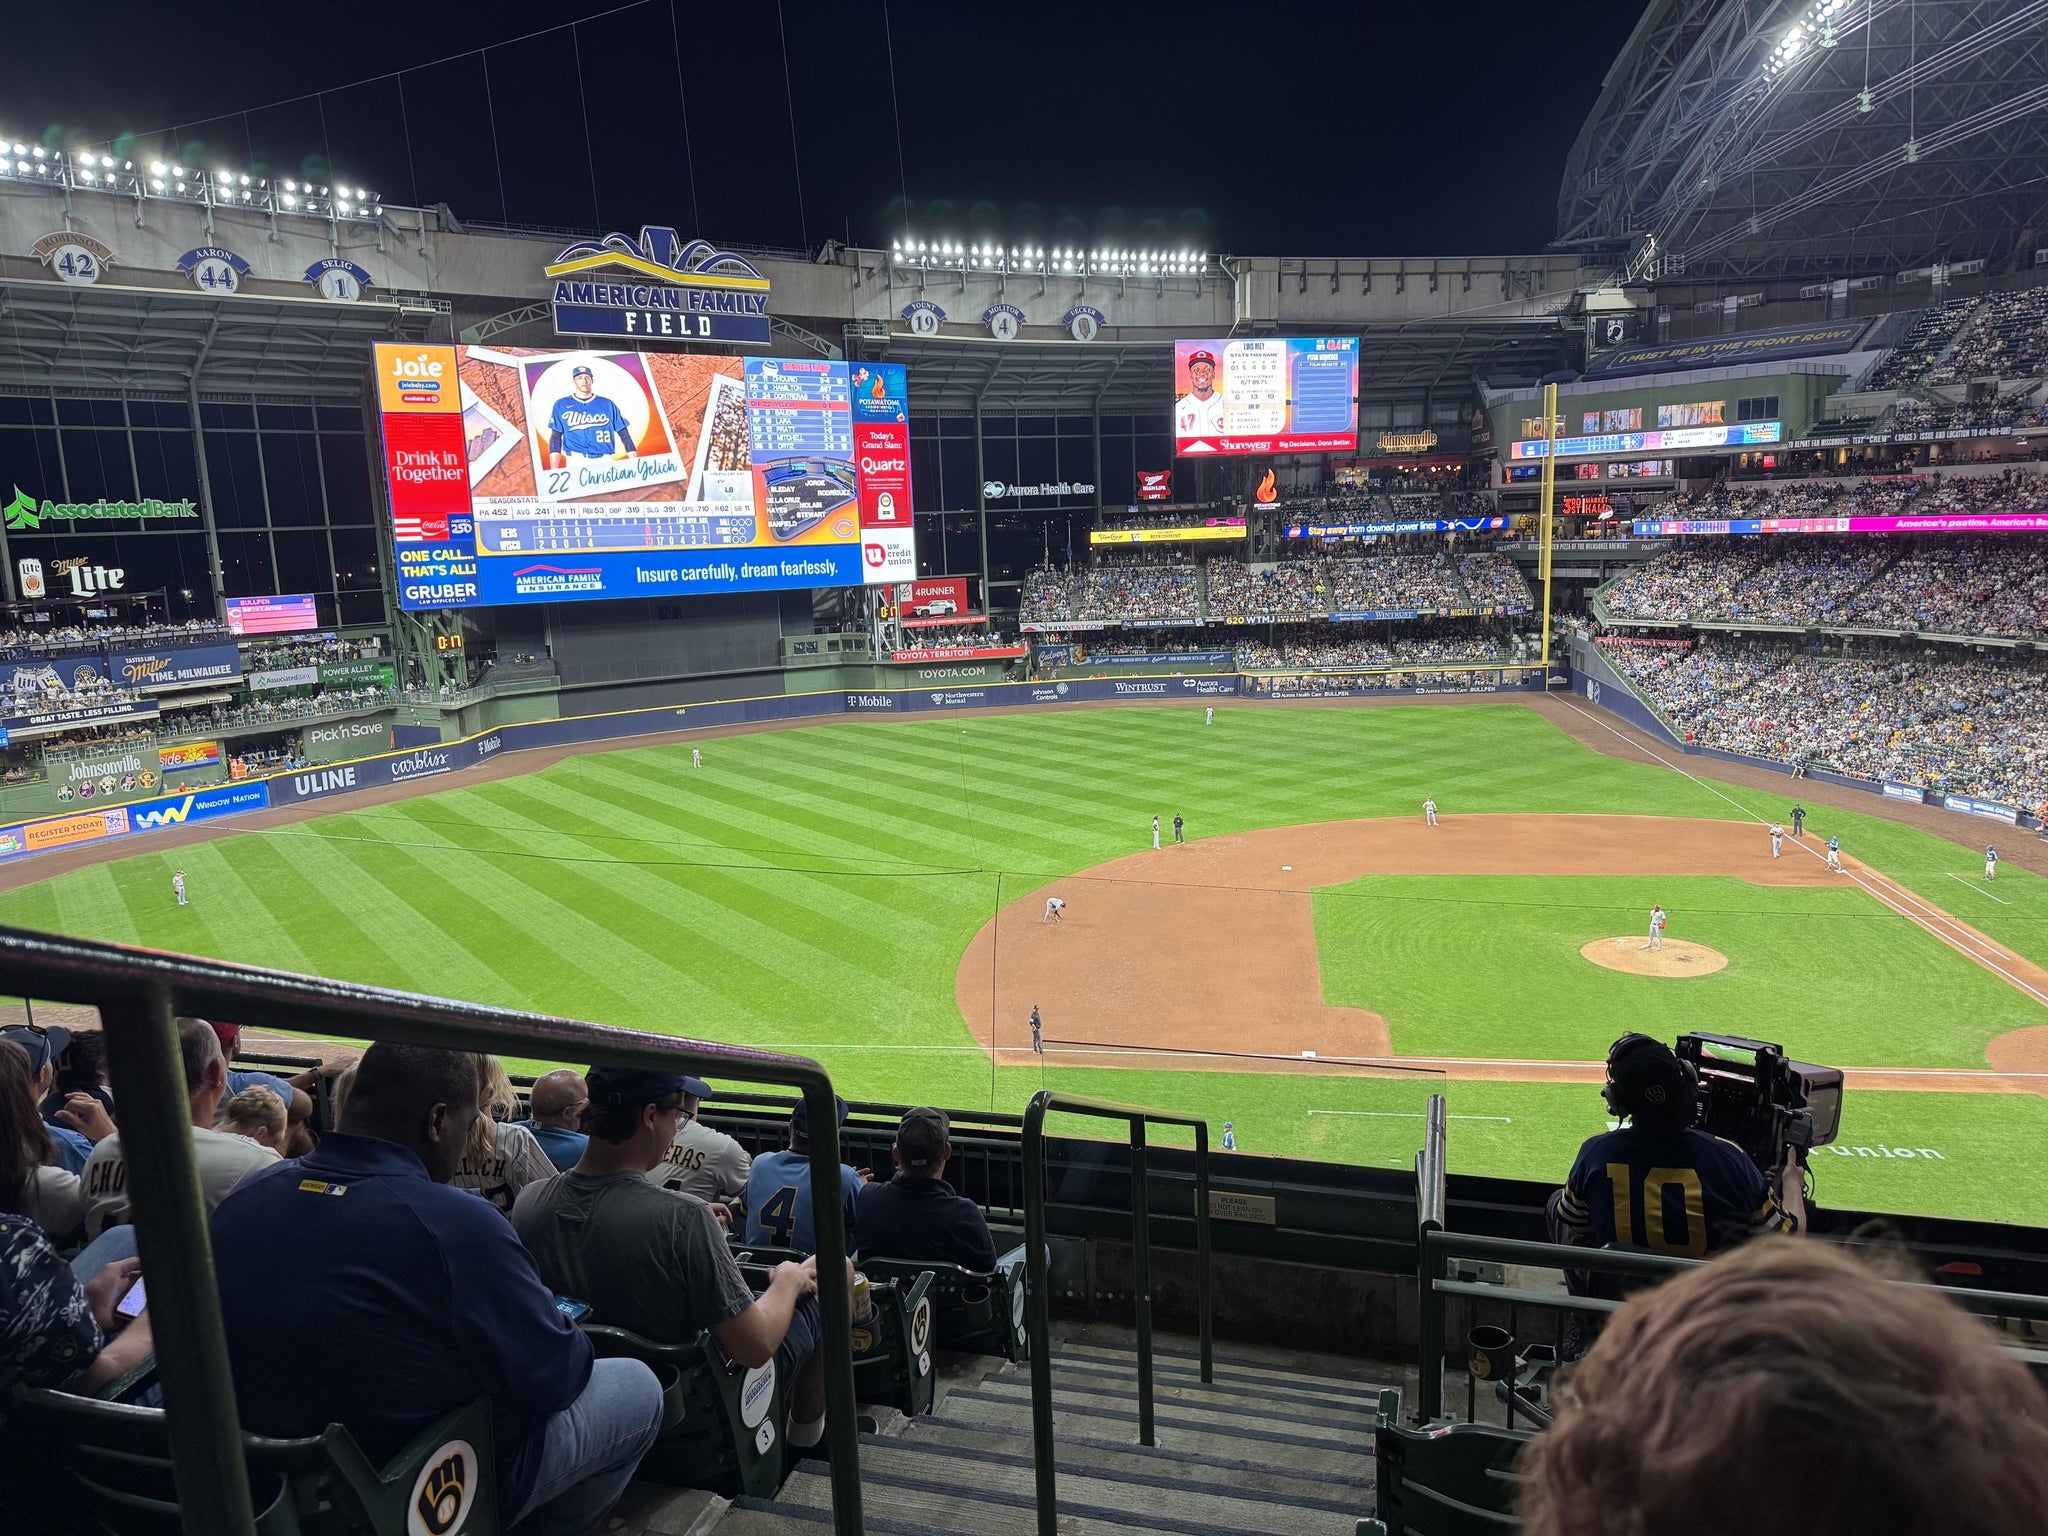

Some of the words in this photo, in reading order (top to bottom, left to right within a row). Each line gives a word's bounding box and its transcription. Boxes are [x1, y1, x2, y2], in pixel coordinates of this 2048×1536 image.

[42, 231, 103, 256] ROBINSON
[195, 247, 233, 263] AARON
[58, 253, 96, 278] 42
[321, 258, 353, 272] SELIG
[200, 265, 234, 289] 44
[335, 278, 348, 299] 1
[552, 281, 682, 311] AMERICAN
[686, 290, 769, 315] FAMILY
[911, 301, 936, 312] YOUNT
[988, 304, 1020, 317] MOLITOR
[1069, 306, 1097, 317] UECKER
[625, 311, 711, 337] FIELD
[913, 315, 935, 333] 19
[998, 319, 1008, 334] 4
[1628, 351, 1669, 362] MUST
[1670, 348, 1690, 356] BE
[1692, 345, 1710, 354] IN
[1712, 342, 1742, 351] THE
[1744, 335, 1797, 348] FRONT
[1801, 329, 1853, 342] ROW!
[392, 353, 442, 378] Joie
[561, 410, 610, 431] Wisco
[1180, 413, 1196, 432] 47
[595, 430, 611, 443] 22
[869, 431, 894, 442] Today's
[1278, 441, 1288, 449] Big
[1289, 440, 1316, 448] Decisions,
[1318, 439, 1332, 447] Done
[1332, 438, 1352, 446] Better.
[1376, 429, 1437, 449] Johnsonville
[1811, 439, 1821, 447] FAN
[1853, 436, 1865, 444] TEXT
[862, 441, 883, 450] Grand
[884, 441, 903, 449] Slam:
[396, 450, 442, 466] Drink
[443, 450, 458, 466] in
[860, 457, 905, 475] Quartz
[392, 465, 464, 484] Together
[548, 471, 571, 495] 22
[579, 465, 637, 488] Christian
[637, 459, 678, 481] Yelich
[1008, 484, 1040, 496] Aurora
[1040, 482, 1071, 495] Health
[1072, 481, 1095, 494] Care
[1585, 496, 1609, 504] MARKET
[479, 509, 490, 517] PA
[492, 508, 508, 517] 452
[516, 508, 531, 516] AVG
[534, 507, 550, 515] .241
[570, 507, 576, 515] 11
[594, 506, 605, 514] 53
[662, 505, 676, 513] .391
[1571, 505, 1582, 514] ST
[451, 523, 473, 534] 250
[1308, 526, 1328, 537] Stay
[1329, 526, 1348, 537] away
[1349, 524, 1365, 533] from
[1366, 523, 1395, 533] downed
[1396, 522, 1418, 534] power
[1419, 520, 1437, 530] lines
[1895, 518, 1947, 529] America's
[1947, 517, 1989, 529] pastime.
[1989, 517, 2034, 528] America's
[400, 550, 430, 563] ONE
[432, 548, 475, 562] CALL...
[887, 549, 911, 558] credit
[21, 560, 42, 576] Lite
[51, 556, 90, 577] Miller
[888, 557, 913, 566] union
[400, 564, 446, 578] THAT'S
[448, 563, 477, 576] ALL!
[636, 565, 680, 583] Insure
[681, 564, 739, 584] carefully,
[741, 562, 778, 579] dream
[781, 559, 839, 579] fearlessly.
[69, 564, 126, 599] Lite
[516, 574, 566, 585] AMERICAN
[567, 573, 601, 583] FAMILY
[405, 582, 477, 600] GRUBER
[523, 583, 597, 592] INSURANCE
[915, 585, 956, 596] 4RUNNER
[1373, 610, 1414, 619] WINTRUST
[1450, 608, 1478, 617] NICOLET
[1479, 607, 1493, 616] LAW
[1149, 619, 1164, 627] TASTE.
[1226, 615, 1245, 625] 620
[1246, 614, 1275, 625] WTMJ
[438, 635, 461, 650] 0:17
[144, 655, 156, 663] LIKE
[895, 650, 929, 661] TOYOTA
[930, 647, 975, 659] TERRITORY
[1038, 647, 1068, 662] Culver's
[122, 657, 172, 684] Miller
[150, 670, 177, 683] TIME,
[178, 664, 232, 680] MILWAUKEE
[322, 665, 350, 678] POWER
[350, 664, 374, 676] ALLEY
[918, 666, 986, 680] TOYOTA.COM
[17, 676, 37, 689] Lite
[1115, 682, 1167, 692] WINTRUST
[1196, 679, 1218, 687] Aurora
[1196, 686, 1218, 694] Health
[1219, 685, 1235, 693] Care
[1469, 685, 1496, 693] BULLPEN
[945, 690, 984, 700] Northwestern
[1032, 687, 1054, 697] Johnson
[1035, 693, 1058, 702] Controls
[858, 695, 892, 708] Mobile
[945, 697, 967, 705] Mutual
[30, 713, 58, 725] GREAT
[59, 710, 83, 721] TASTE.
[83, 708, 103, 719] LESS
[103, 704, 135, 716] FILLING.
[351, 722, 384, 737] Save
[484, 735, 502, 754] Mobile
[68, 755, 143, 781] Johnsonville
[390, 750, 450, 775] carbliss
[294, 766, 357, 796] ULINE
[195, 796, 230, 811] WINDOW
[232, 792, 262, 804] NATION
[29, 825, 70, 840] REGISTER
[71, 820, 103, 834] TODAY!
[1823, 1143, 1947, 1160] union
[1217, 1203, 1232, 1211] NOT
[1233, 1205, 1251, 1213] LEAN
[1221, 1196, 1248, 1206] PLEASE
[1214, 1209, 1233, 1218] OVER
[1234, 1211, 1266, 1221] RAILINGS
[1605, 1162, 1709, 1258] 10
[759, 1186, 799, 1252] 4
[761, 1429, 769, 1446] 3
